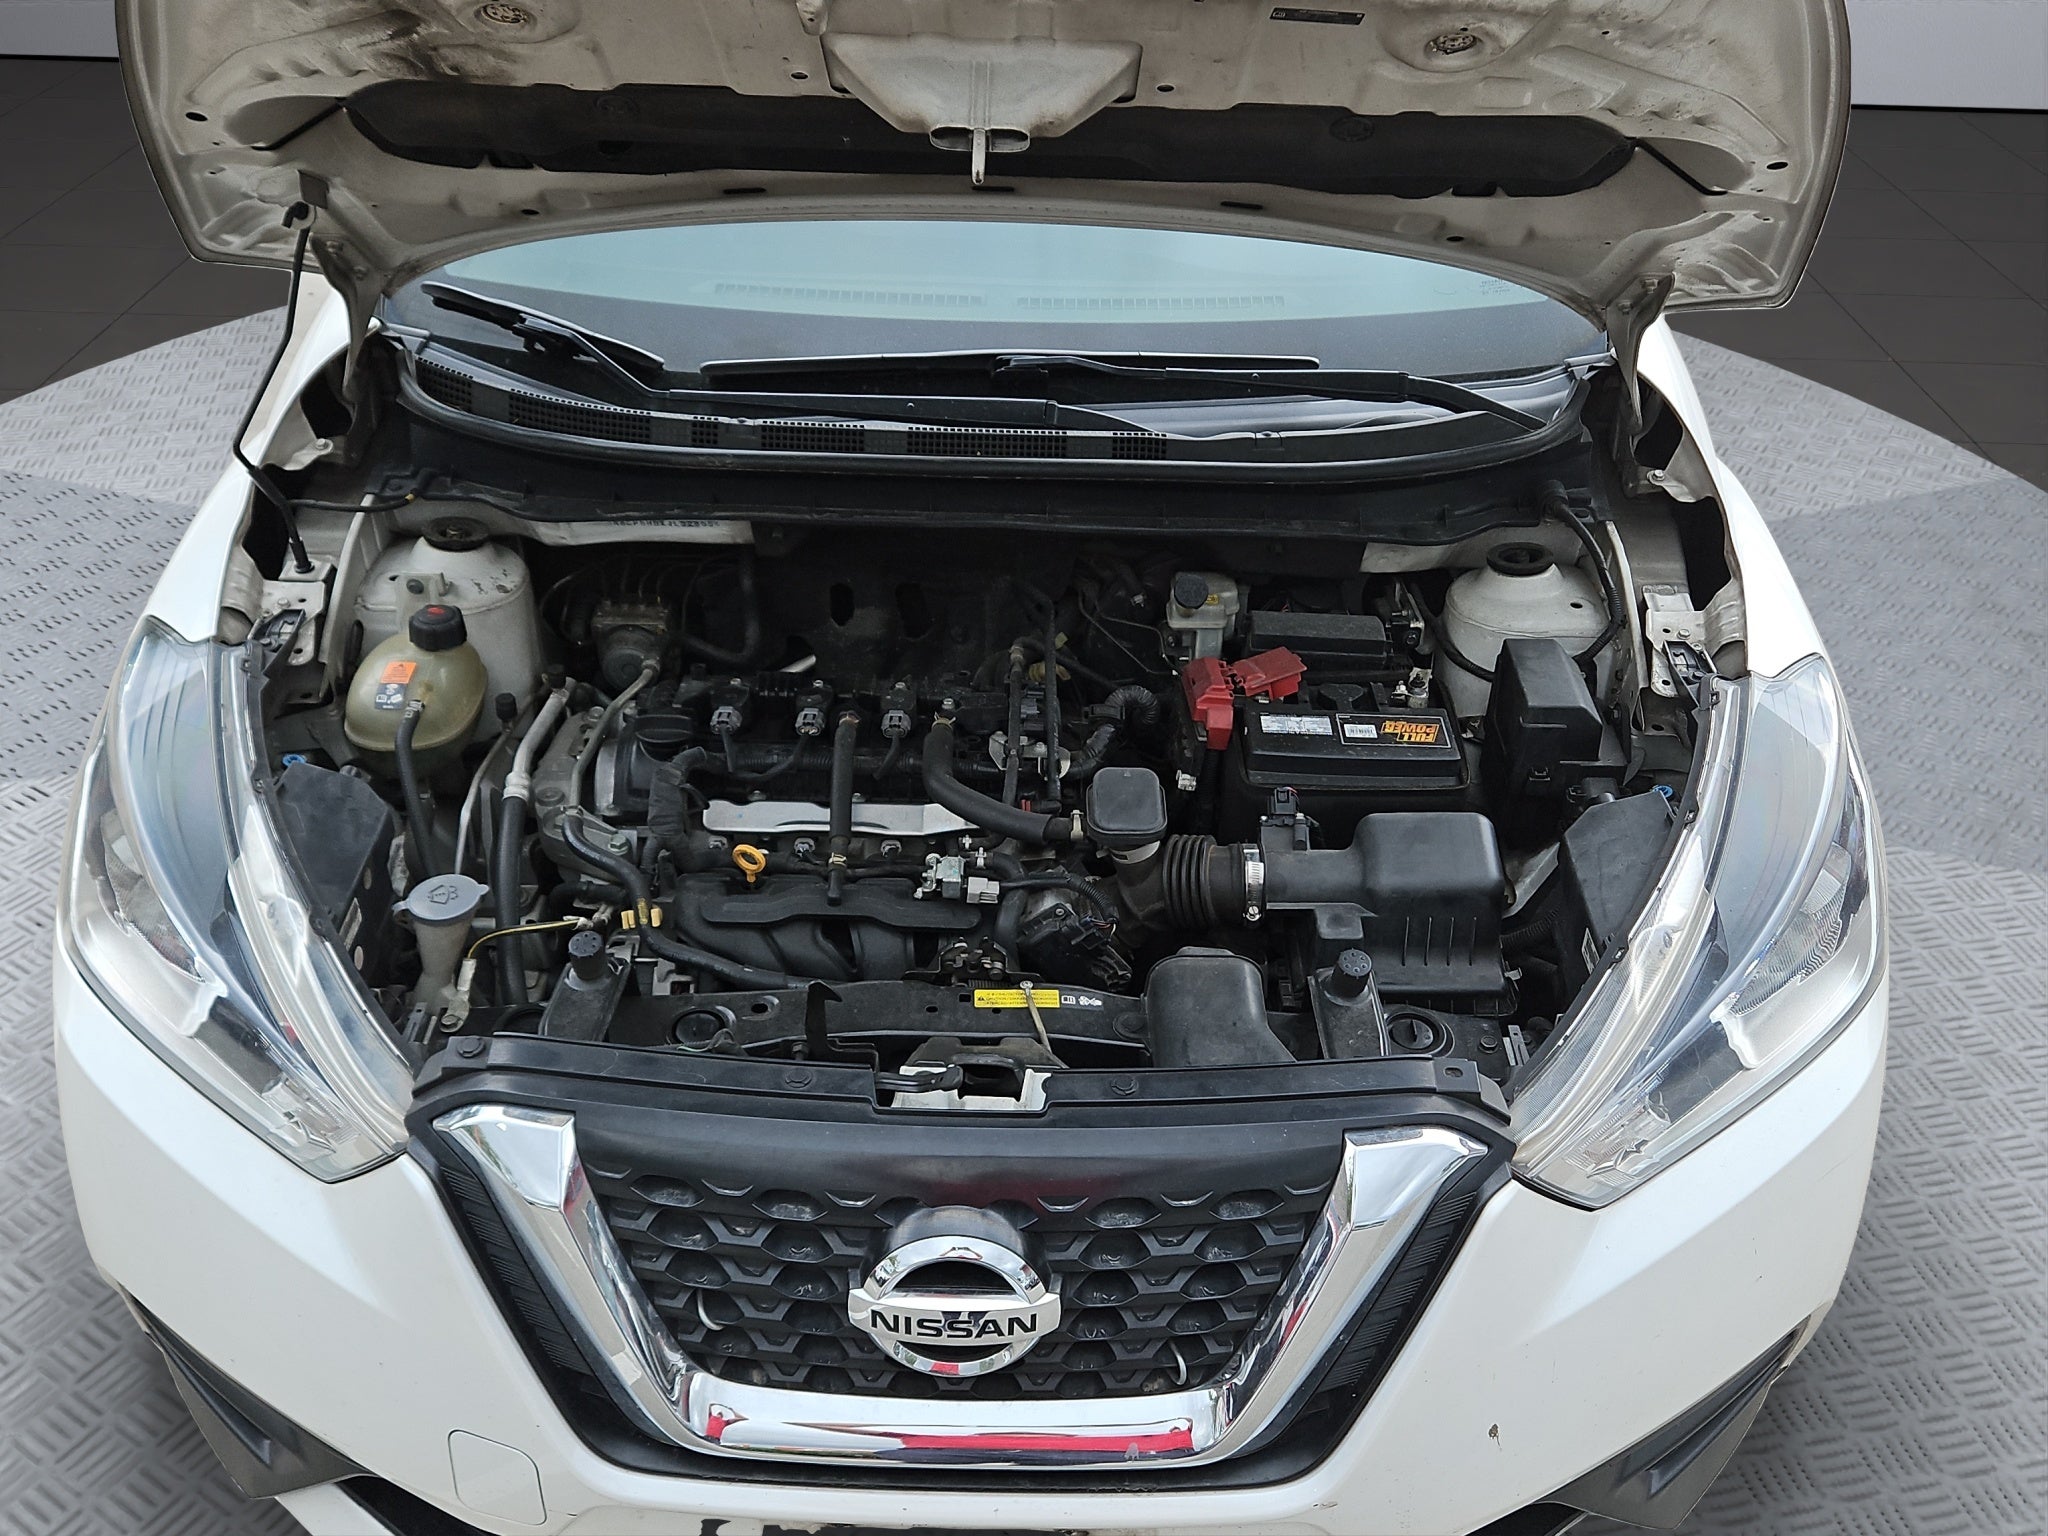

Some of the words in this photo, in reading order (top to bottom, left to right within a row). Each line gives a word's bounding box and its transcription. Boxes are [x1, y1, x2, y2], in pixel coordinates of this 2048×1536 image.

[1385, 721, 1436, 733] POWER
[1402, 732, 1434, 742] FULL
[871, 1309, 1037, 1338] NISSAN
